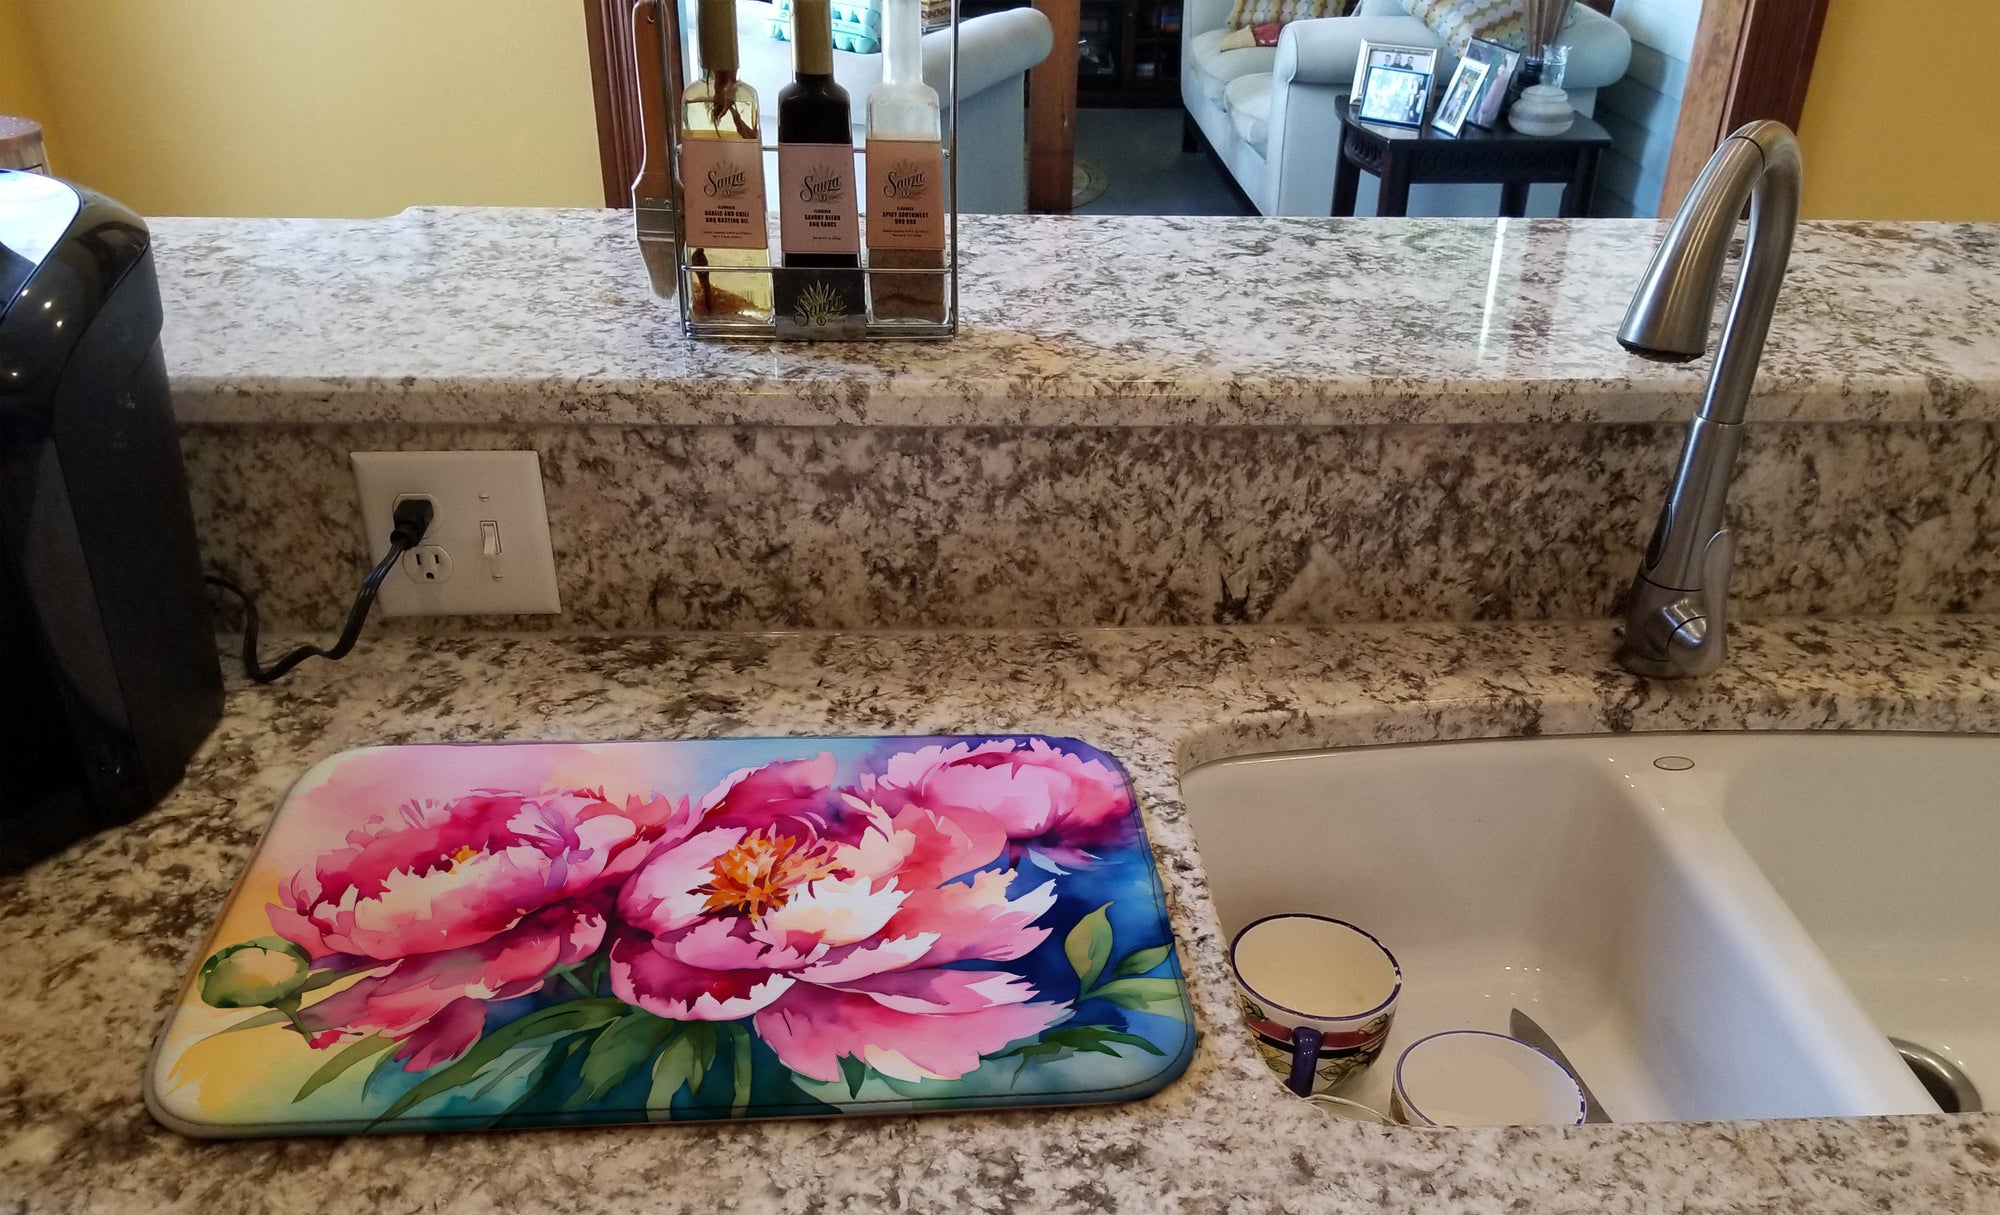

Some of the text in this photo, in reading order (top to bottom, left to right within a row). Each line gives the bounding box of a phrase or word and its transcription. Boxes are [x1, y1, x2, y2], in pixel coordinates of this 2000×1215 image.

[704, 170, 746, 198] Sauza
[800, 176, 841, 202] Sauza
[884, 172, 926, 198] Sauza
[792, 295, 844, 326] Sauza
